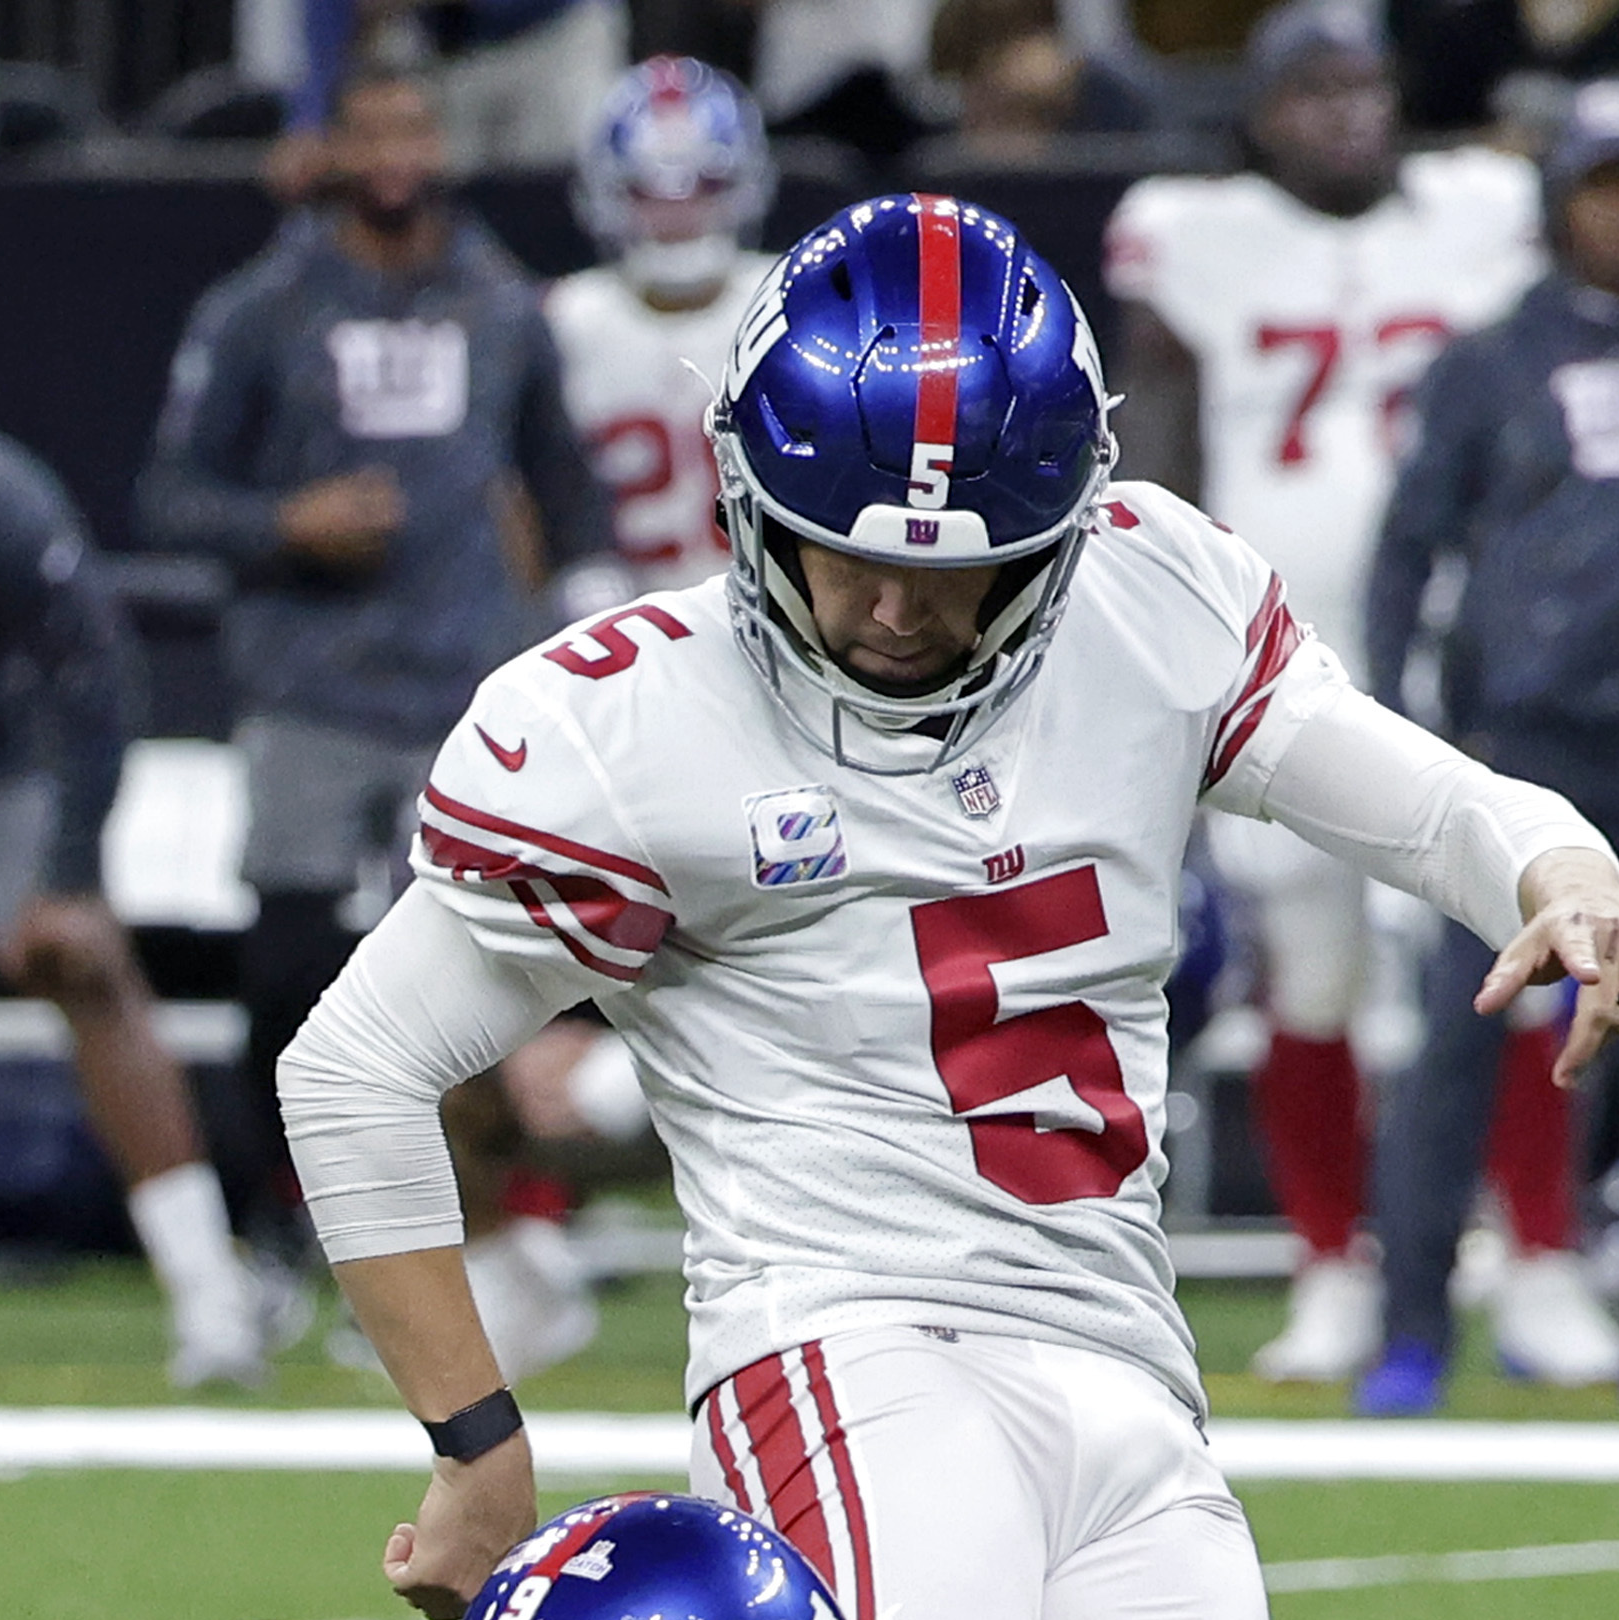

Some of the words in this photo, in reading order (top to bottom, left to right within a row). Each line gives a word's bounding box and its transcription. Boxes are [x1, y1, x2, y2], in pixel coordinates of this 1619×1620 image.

[586, 414, 730, 565] 2
[907, 442, 955, 510] 5
[543, 604, 693, 681] 5
[961, 786, 999, 814] NFL
[910, 862, 1149, 1206] 5
